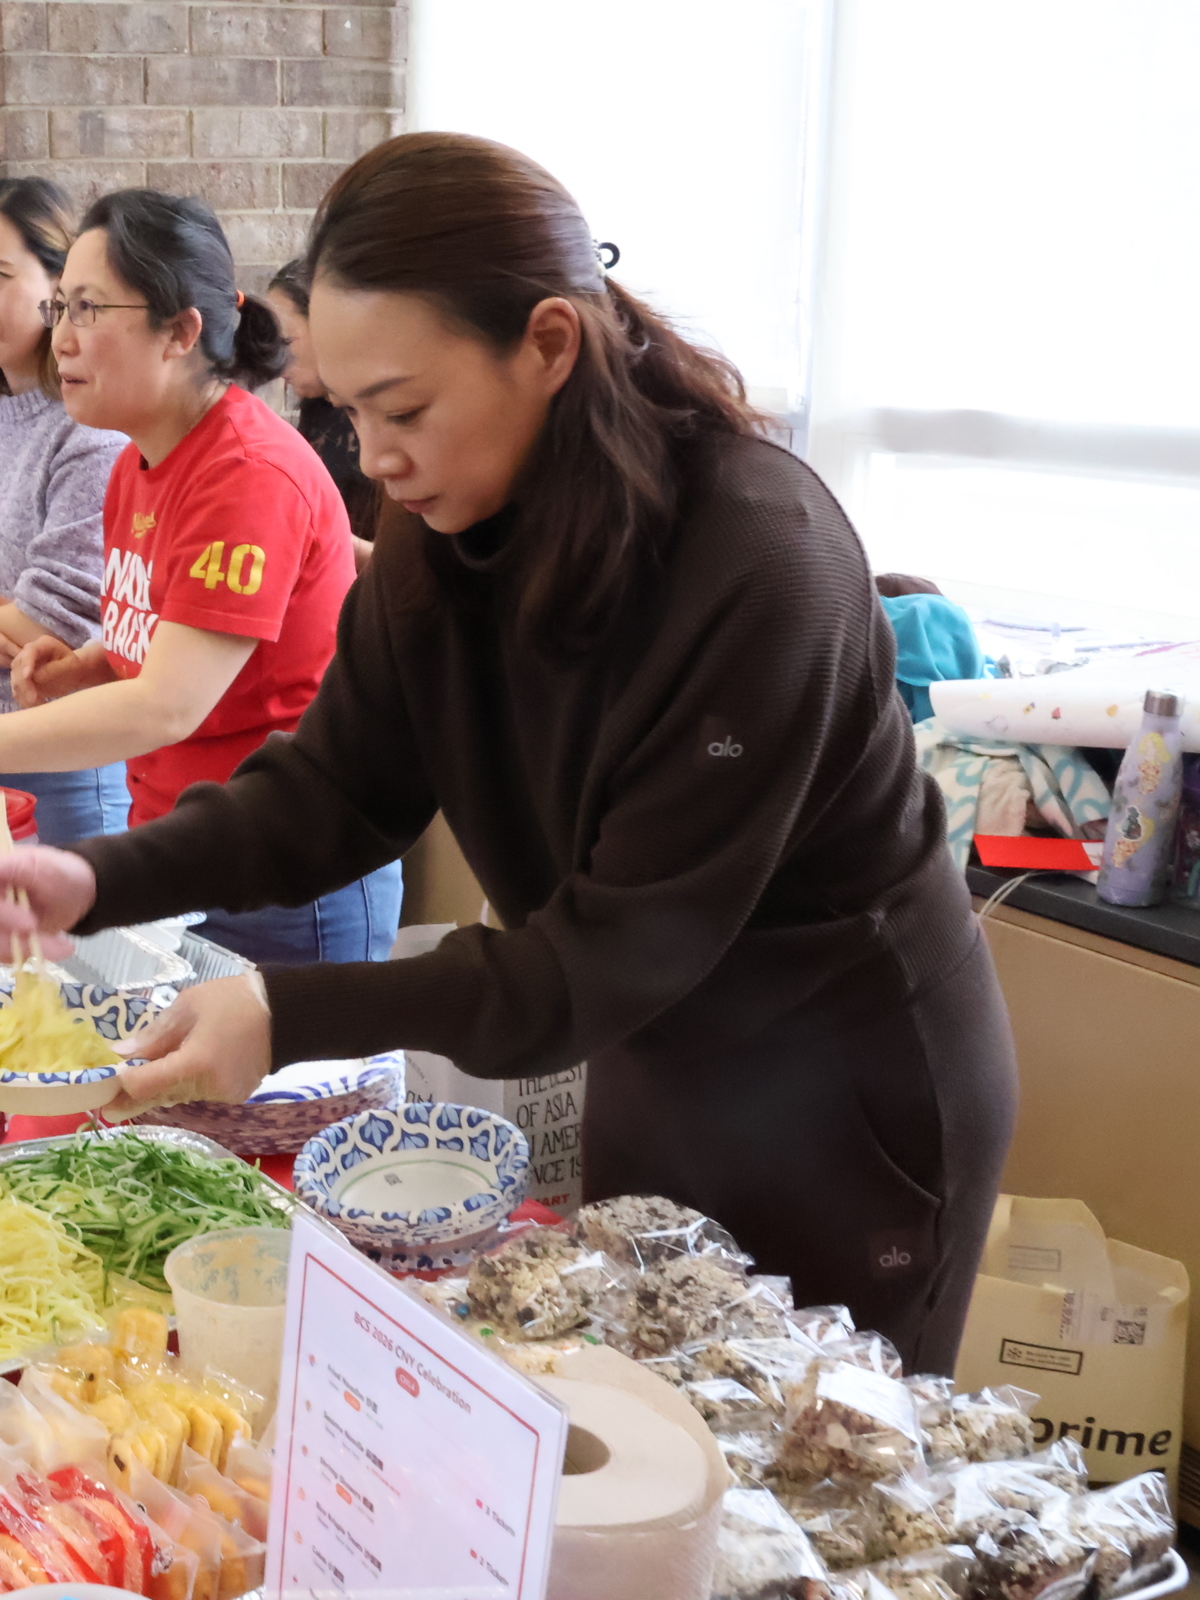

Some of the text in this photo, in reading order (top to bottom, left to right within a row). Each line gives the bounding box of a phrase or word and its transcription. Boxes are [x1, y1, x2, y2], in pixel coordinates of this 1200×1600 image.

[189, 541, 266, 596] 40
[707, 735, 744, 758] alo
[516, 1091, 578, 1129] OF ASIA
[878, 1245, 912, 1267] alo
[354, 1311, 370, 1333] BCS
[372, 1326, 393, 1352] 2026
[395, 1345, 415, 1368] CNY
[417, 1362, 471, 1415] Celebration
